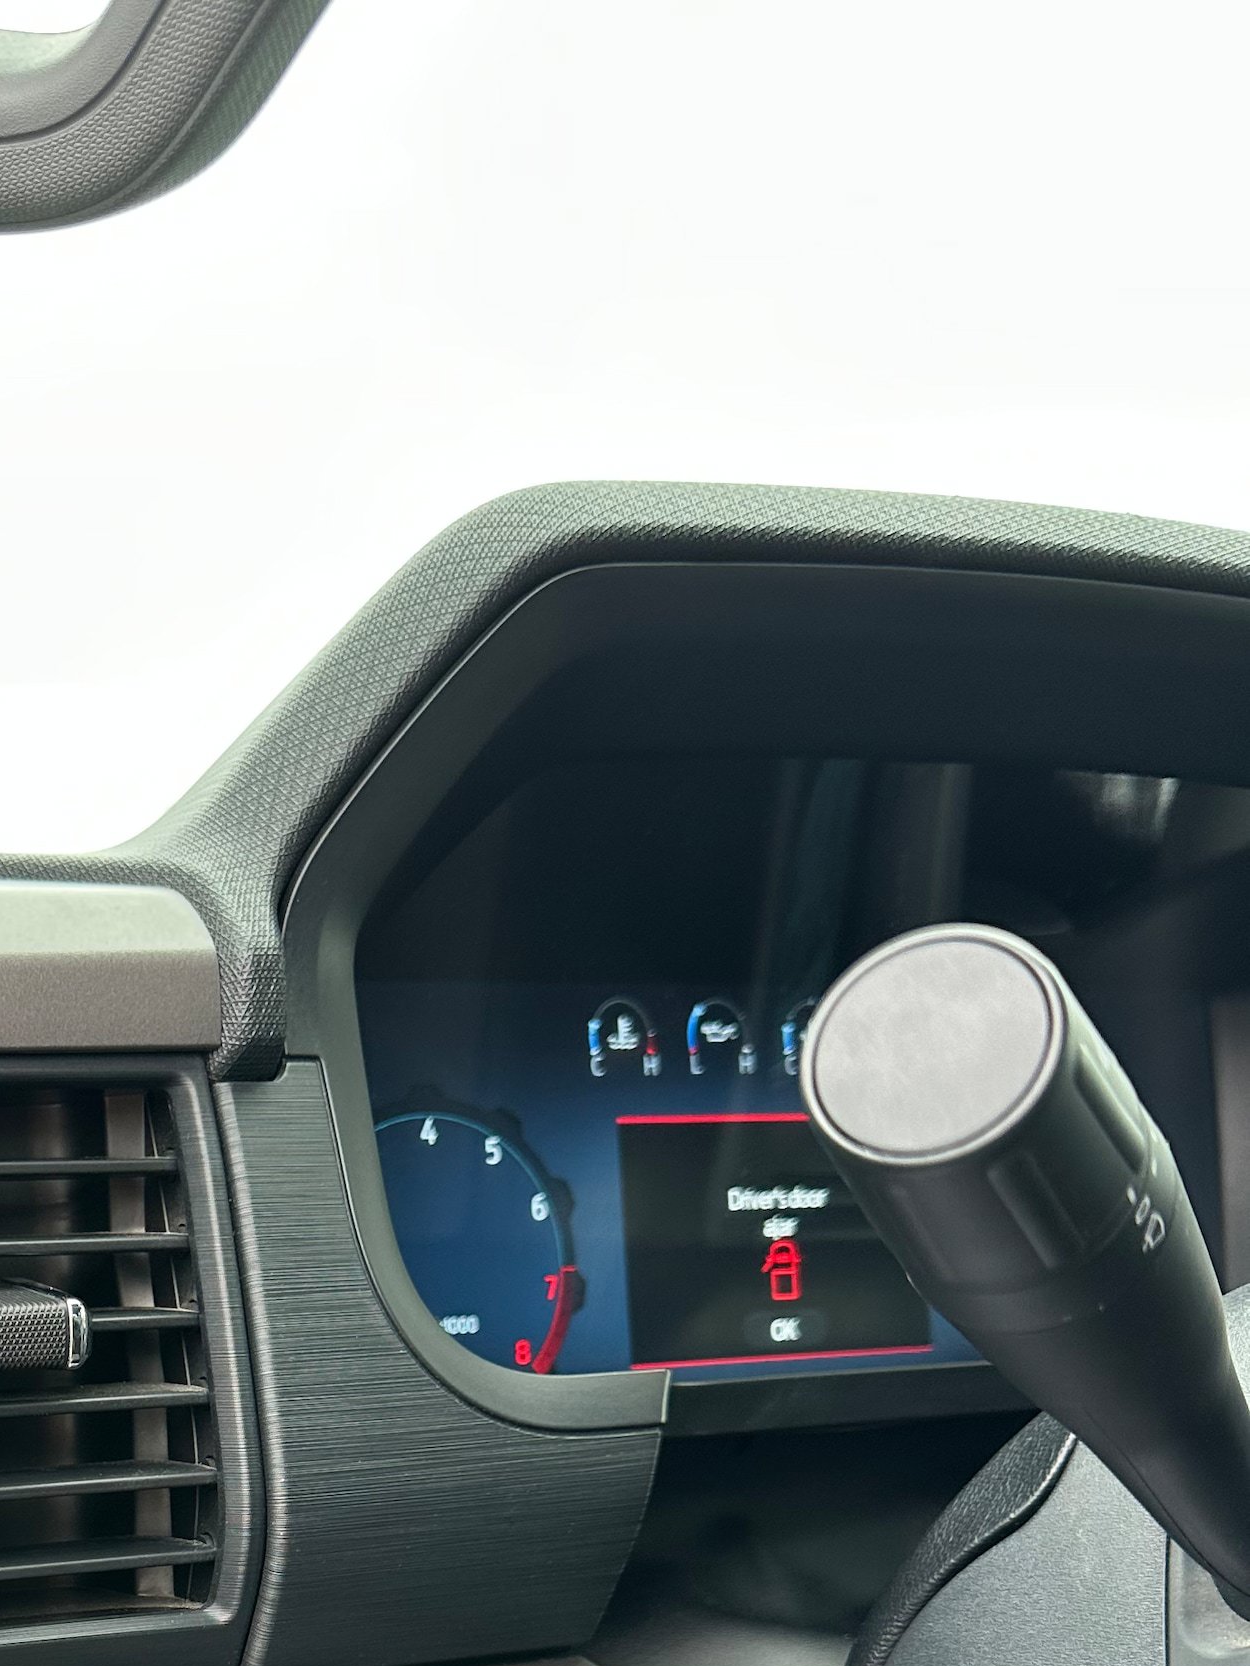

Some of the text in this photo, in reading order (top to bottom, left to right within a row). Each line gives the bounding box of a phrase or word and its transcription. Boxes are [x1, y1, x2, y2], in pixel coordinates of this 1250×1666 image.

[590, 1053, 607, 1077] C
[420, 1115, 439, 1146] 4
[485, 1136, 502, 1165] 5
[531, 1192, 549, 1221] 6
[728, 1184, 830, 1211] Driver's door
[544, 1275, 558, 1300] 7
[770, 1317, 801, 1342] OK
[515, 1339, 532, 1365] 8
